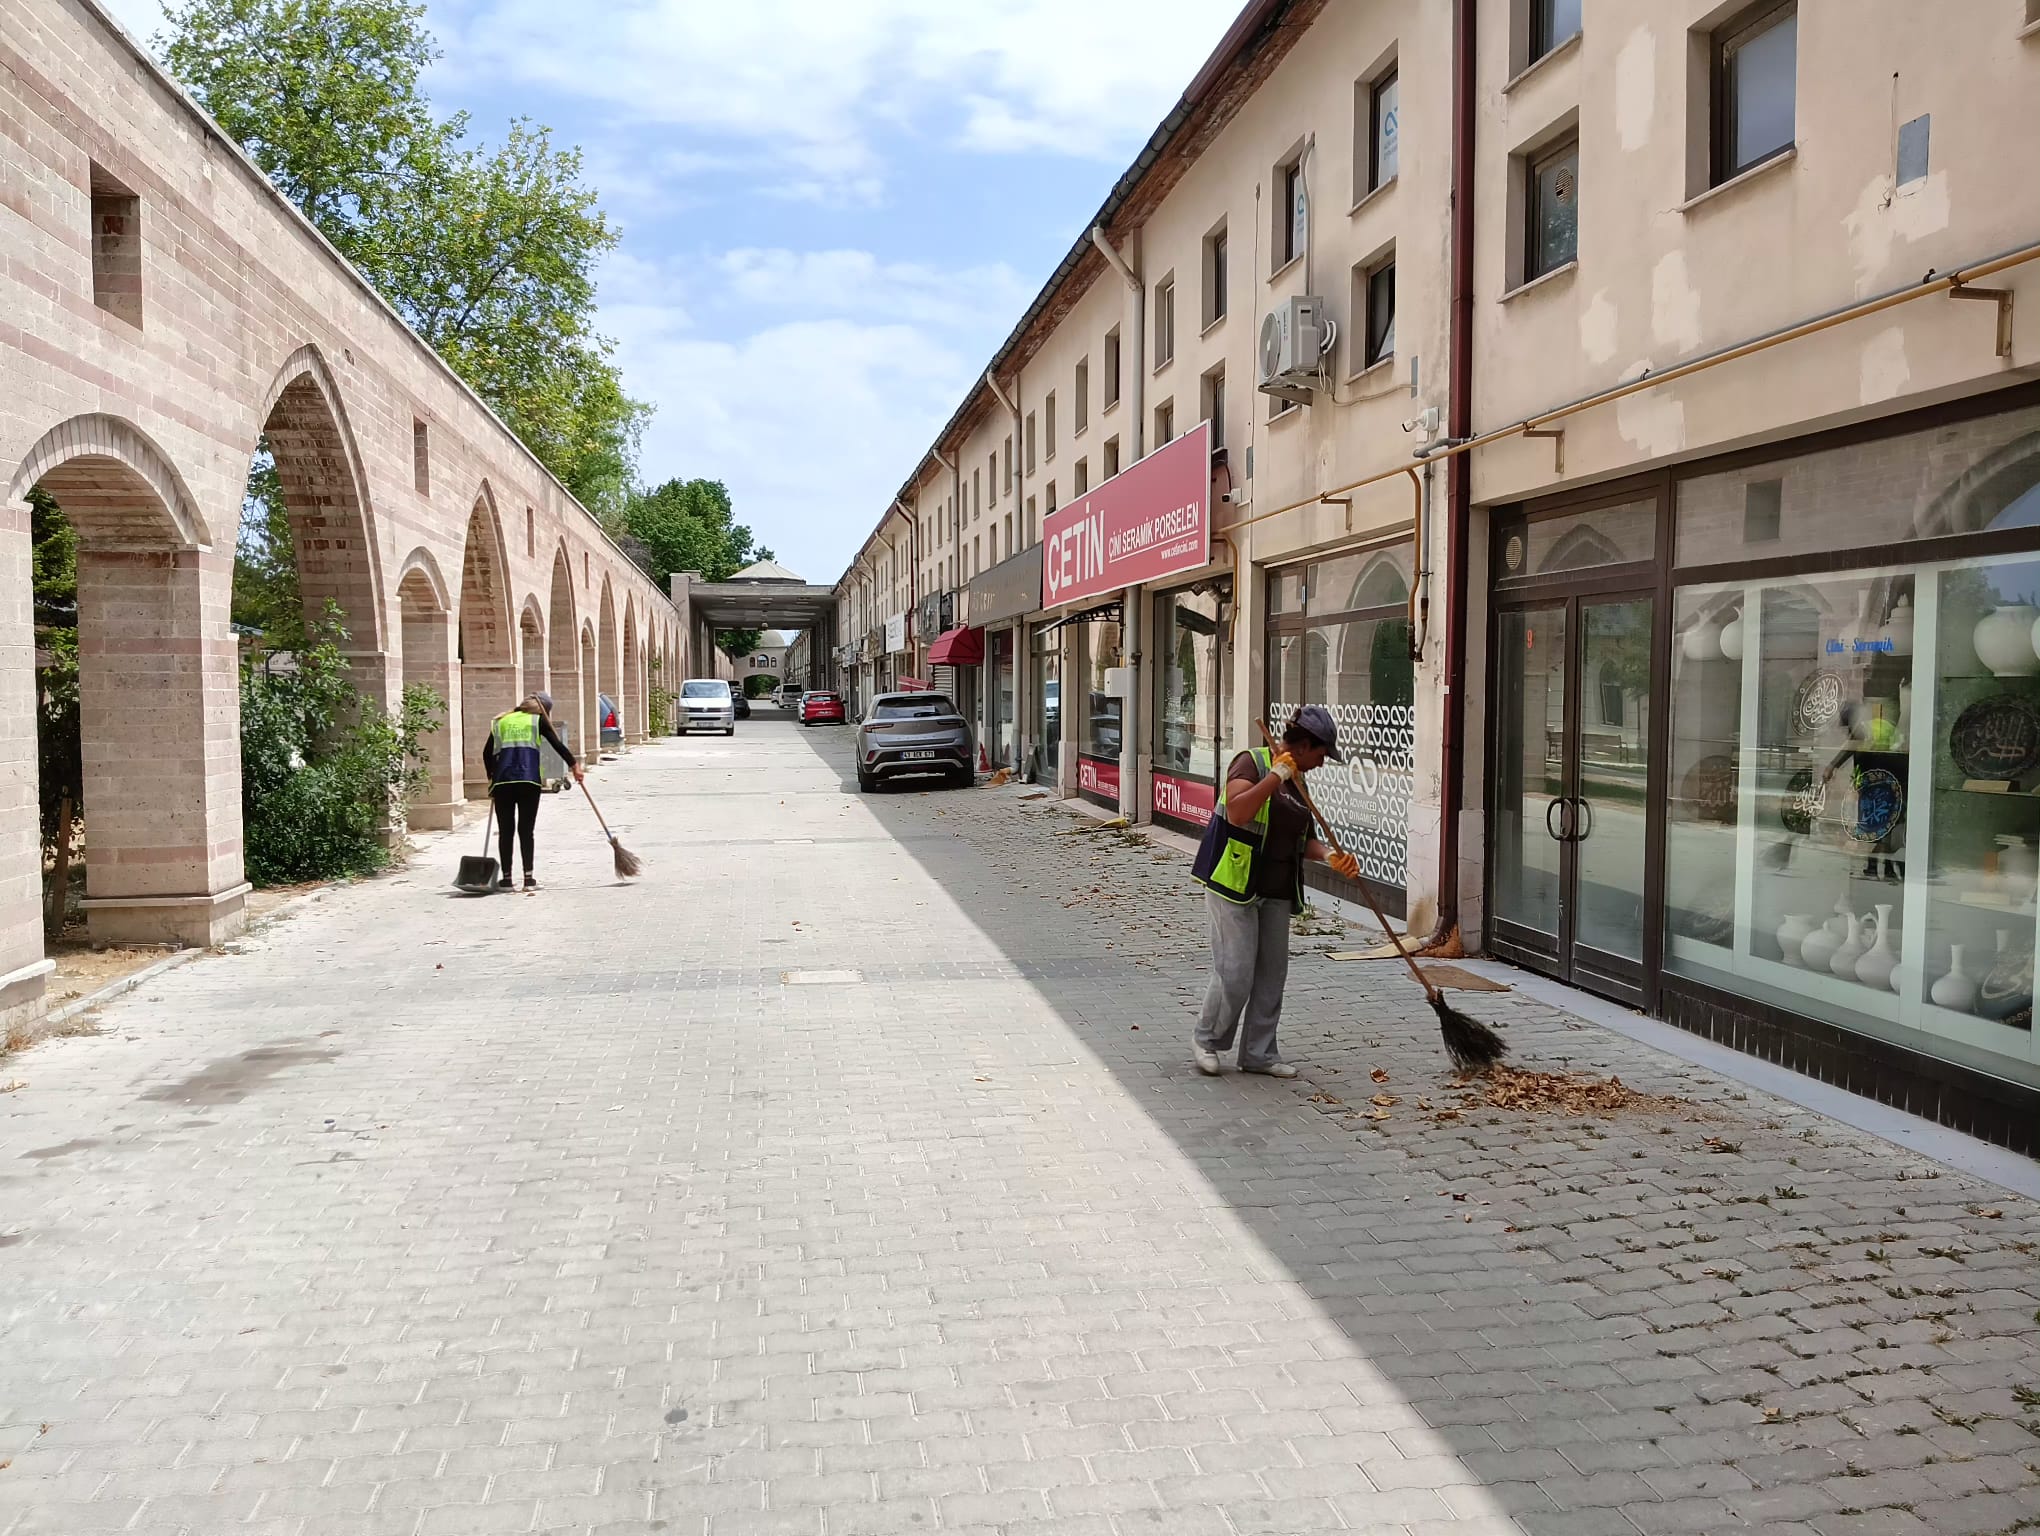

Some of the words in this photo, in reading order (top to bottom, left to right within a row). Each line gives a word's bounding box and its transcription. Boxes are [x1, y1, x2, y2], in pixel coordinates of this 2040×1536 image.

[1122, 516, 1153, 553] SERAMİK
[1154, 501, 1199, 542] PORSELEN
[1048, 501, 1104, 599] ÇETİN
[1080, 761, 1097, 789] ÇETİN
[1155, 778, 1180, 814] ÇETİN
[1349, 797, 1377, 812] ADVANCED
[1349, 809, 1377, 825] DYNAMICS
